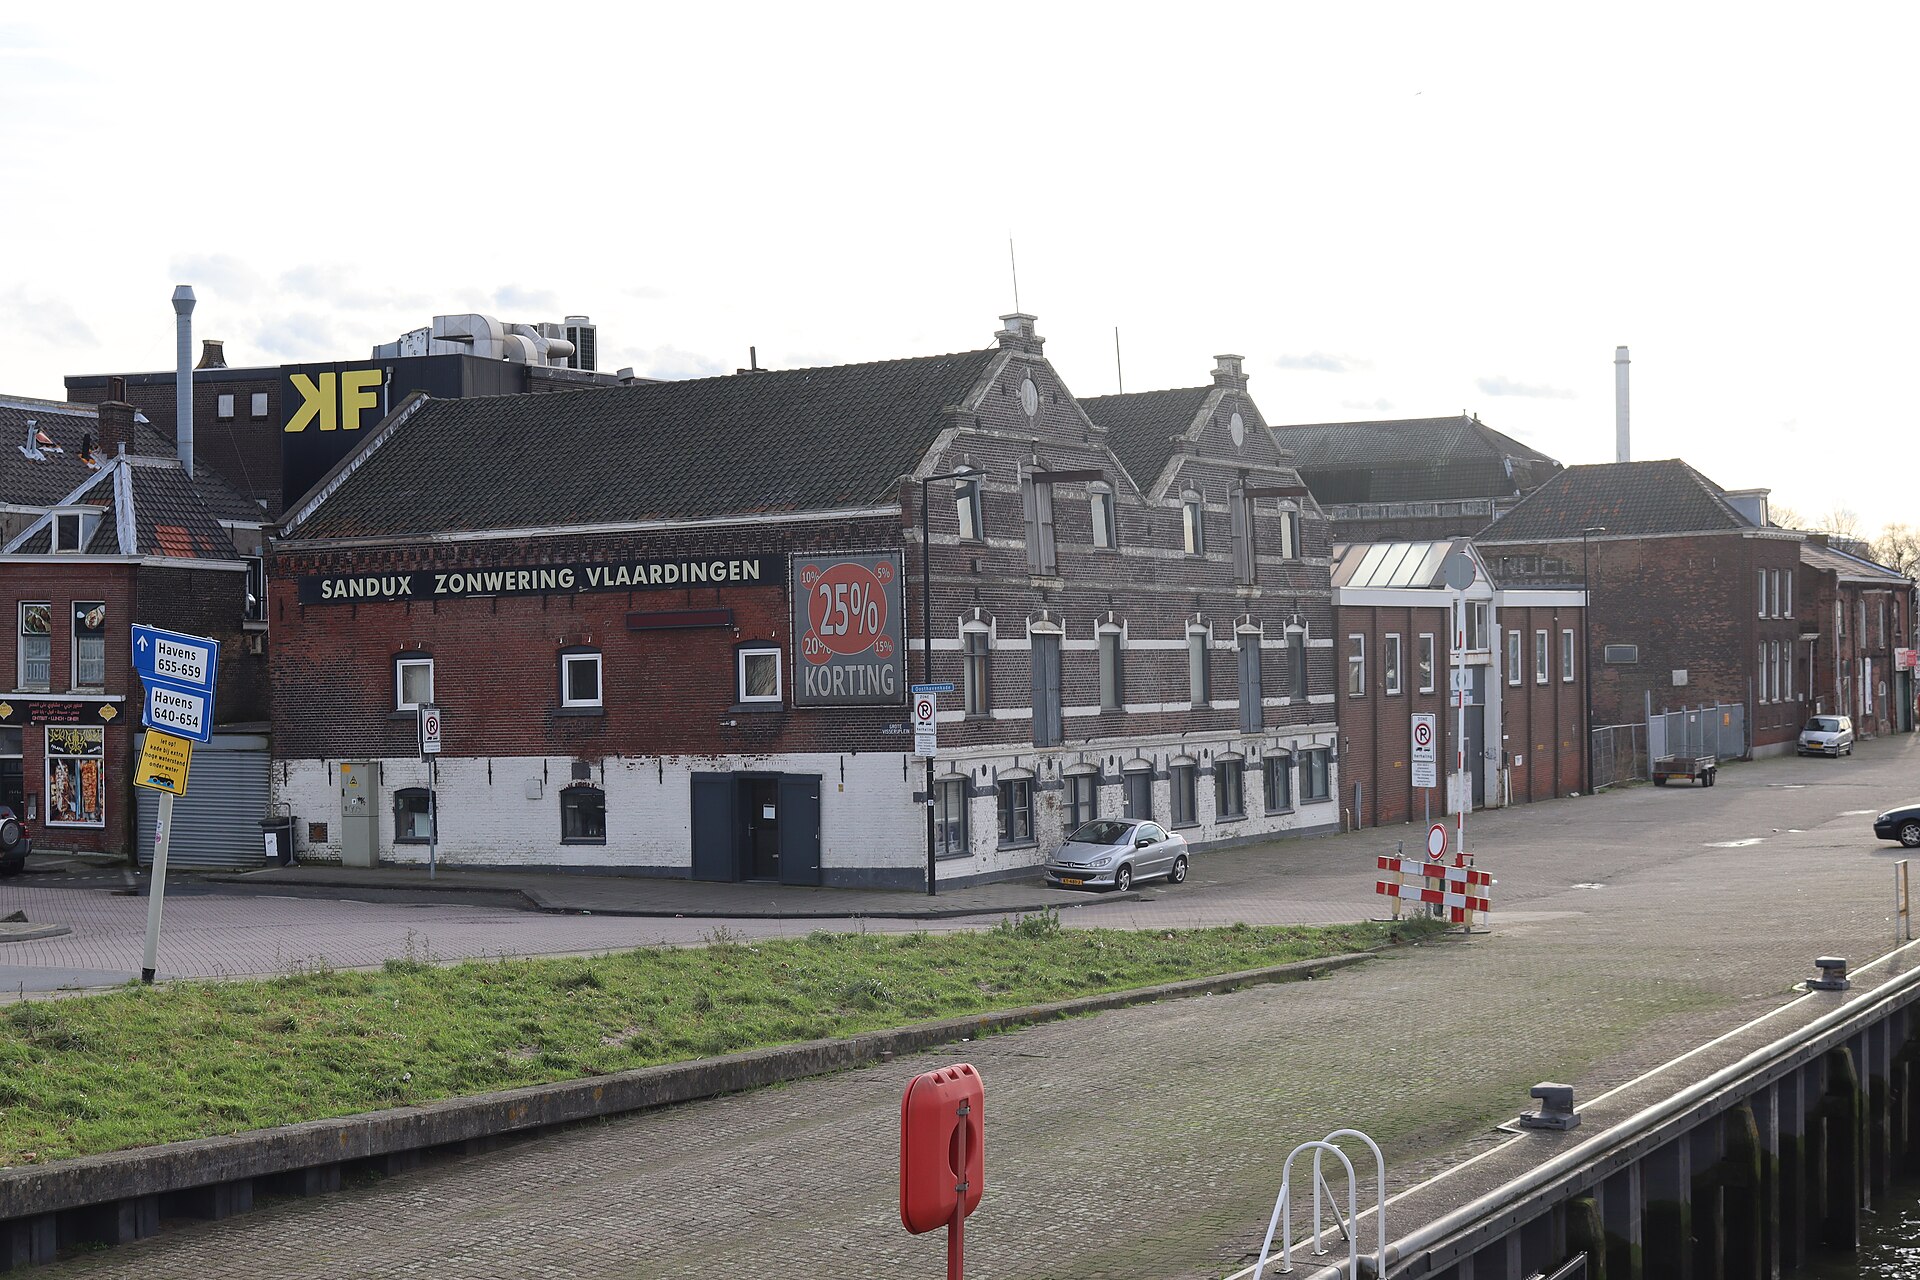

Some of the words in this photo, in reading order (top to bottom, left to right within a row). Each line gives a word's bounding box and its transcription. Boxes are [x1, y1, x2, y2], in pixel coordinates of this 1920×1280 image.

[321, 576, 412, 599] SANDUX
[434, 569, 575, 594] ZONWERING
[586, 559, 760, 586] VLAARDINGEN
[801, 571, 819, 584] 10%
[877, 567, 890, 579] 5%
[819, 582, 879, 636] 25%
[159, 642, 196, 661] Havens
[875, 640, 892, 653] 15%
[158, 659, 201, 678] 655-659
[805, 663, 894, 697] KORTING
[154, 690, 193, 710] Havens
[154, 707, 199, 728] 640-654
[158, 755, 185, 767] waterstand
